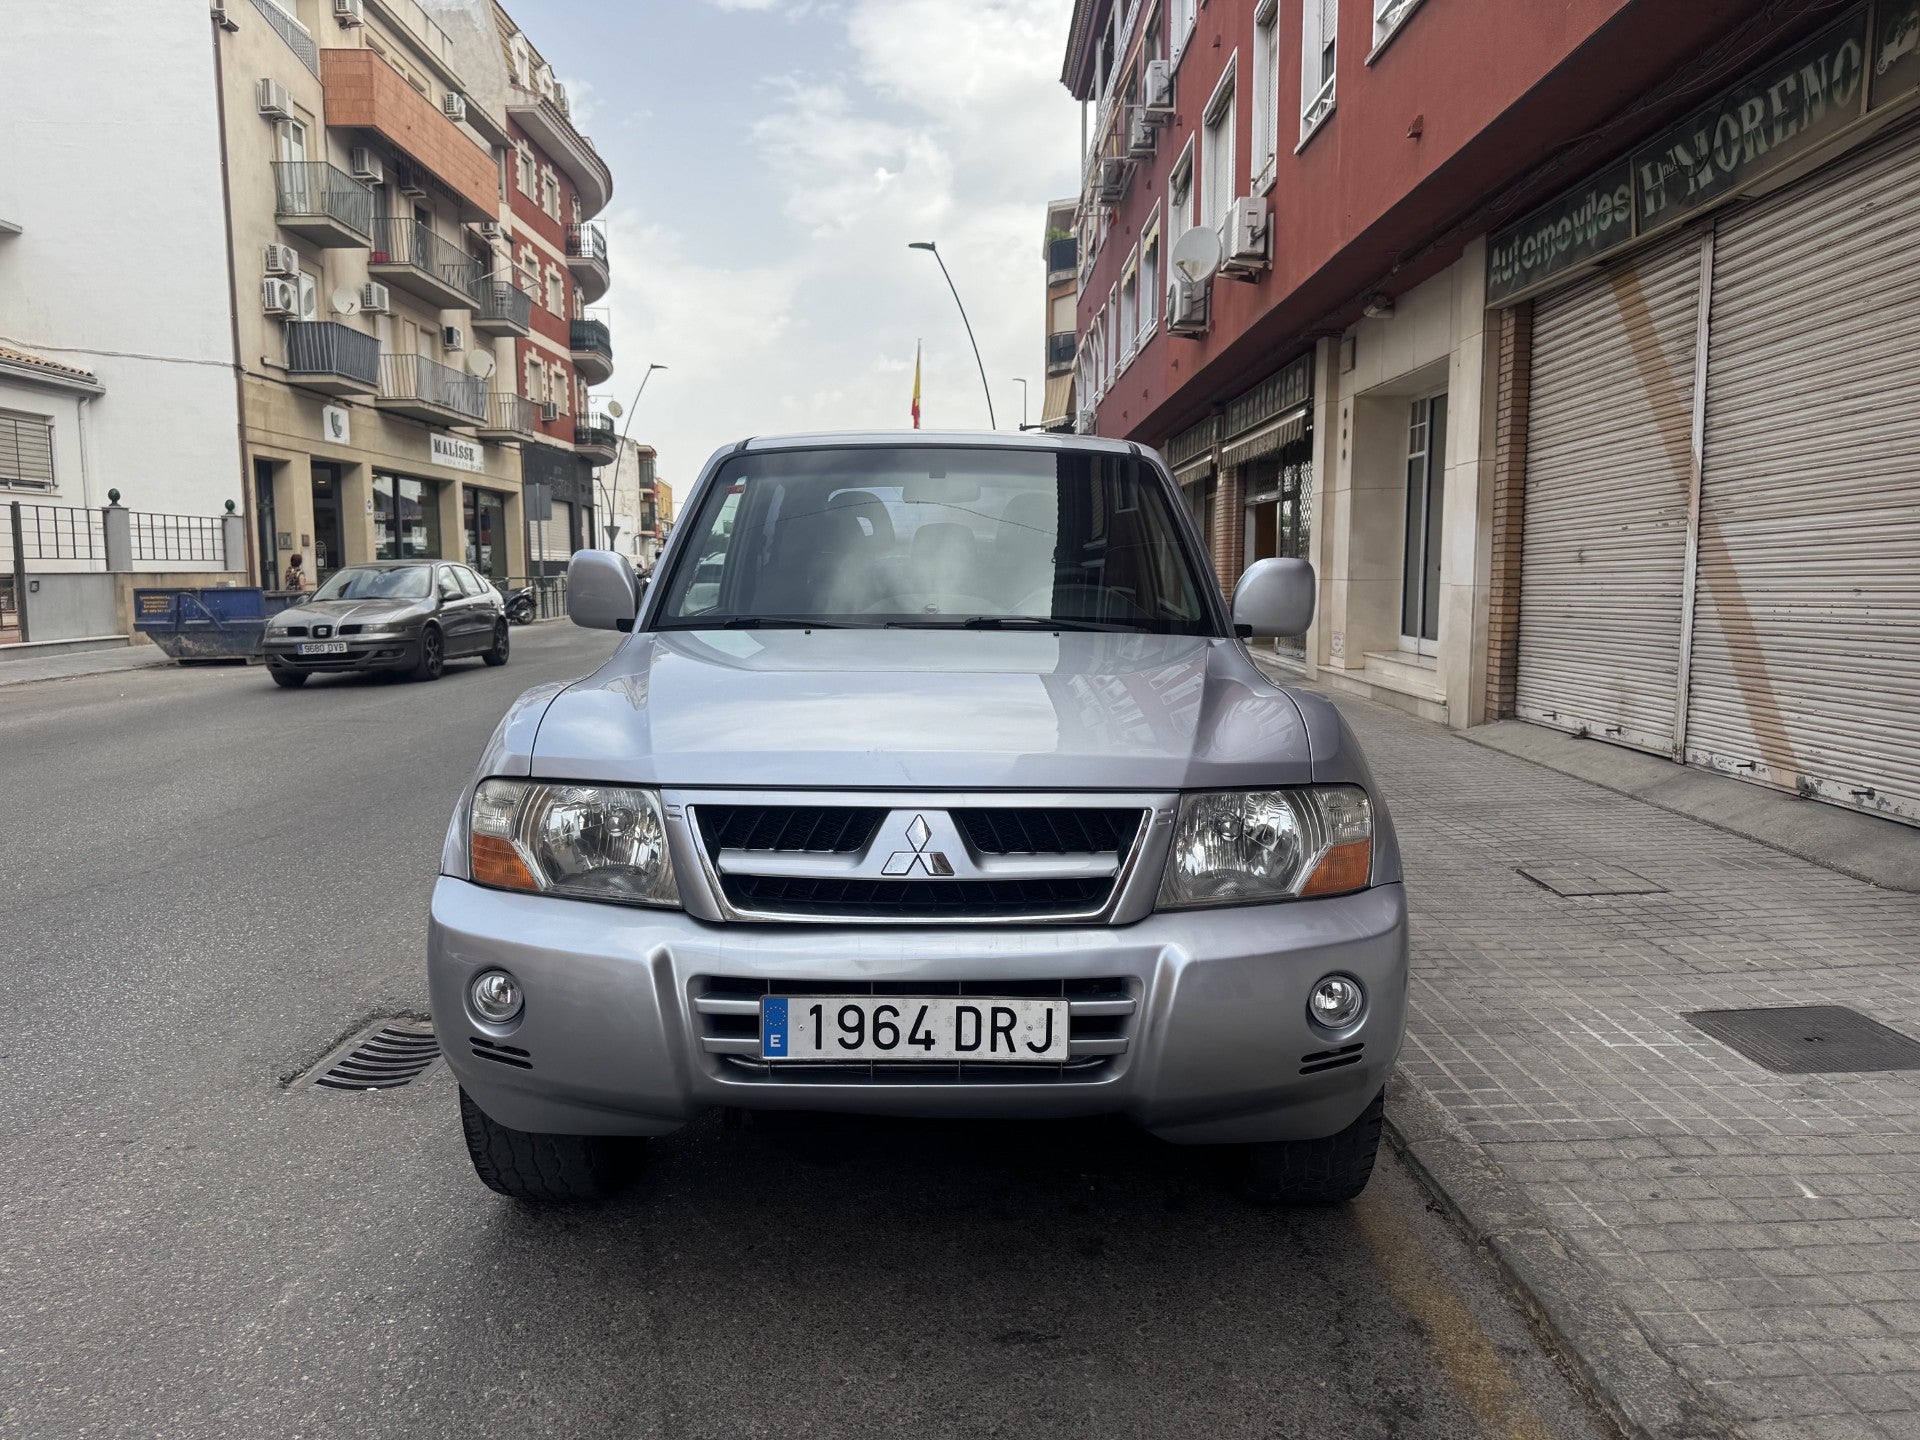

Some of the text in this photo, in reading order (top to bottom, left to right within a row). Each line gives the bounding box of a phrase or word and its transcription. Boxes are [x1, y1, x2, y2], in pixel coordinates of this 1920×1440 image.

[1667, 38, 1862, 197] MORENO
[433, 438, 475, 462] MALÍSSE
[304, 642, 345, 653] 9680 DVB
[770, 1004, 1054, 1053] E 1964 DRJ
